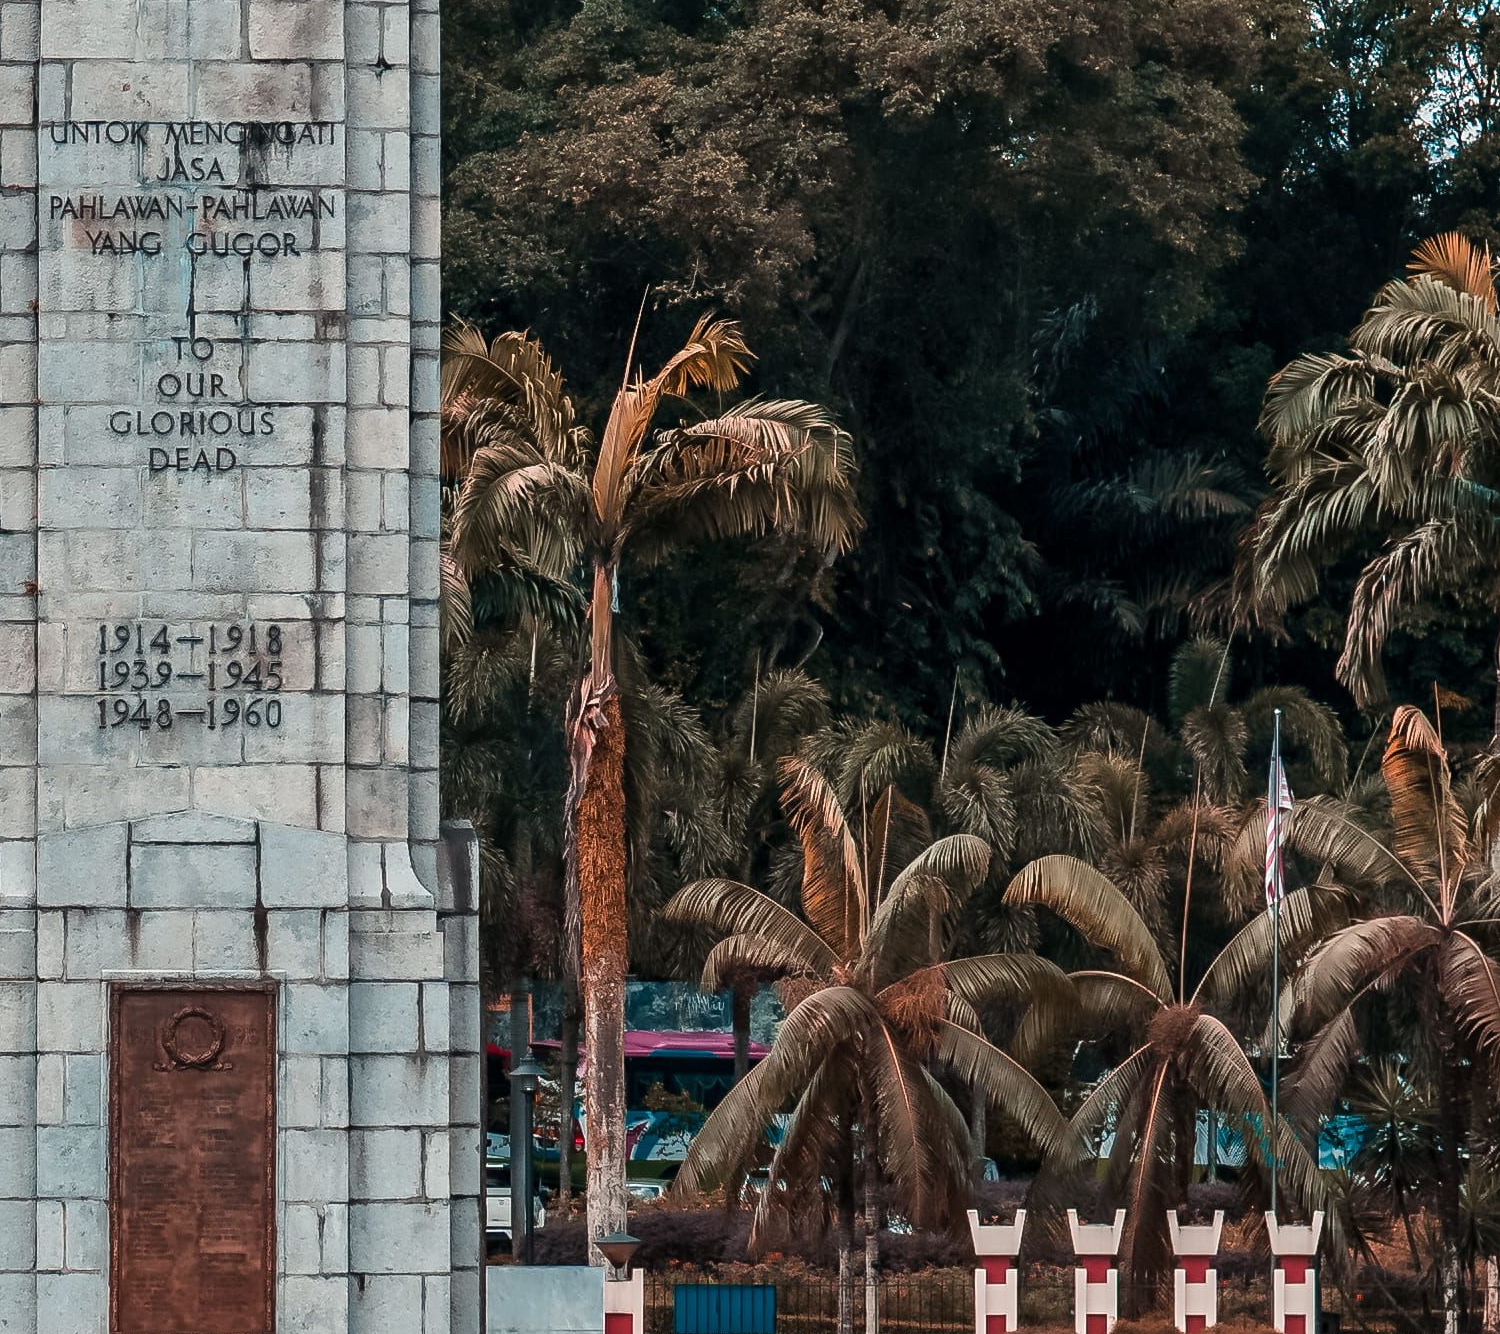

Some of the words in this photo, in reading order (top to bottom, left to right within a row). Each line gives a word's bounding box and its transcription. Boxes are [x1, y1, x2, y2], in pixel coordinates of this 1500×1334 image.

[50, 120, 149, 145] UNTOK
[156, 157, 225, 182] JASA
[50, 194, 336, 220] PAHLAWAN-PAHLAWAN
[85, 230, 162, 256] YANG
[186, 231, 300, 257] GUGOR
[171, 336, 215, 361] TO
[157, 372, 228, 398] OUR
[109, 410, 276, 437] GLORIOUS
[149, 447, 237, 472] DEAD
